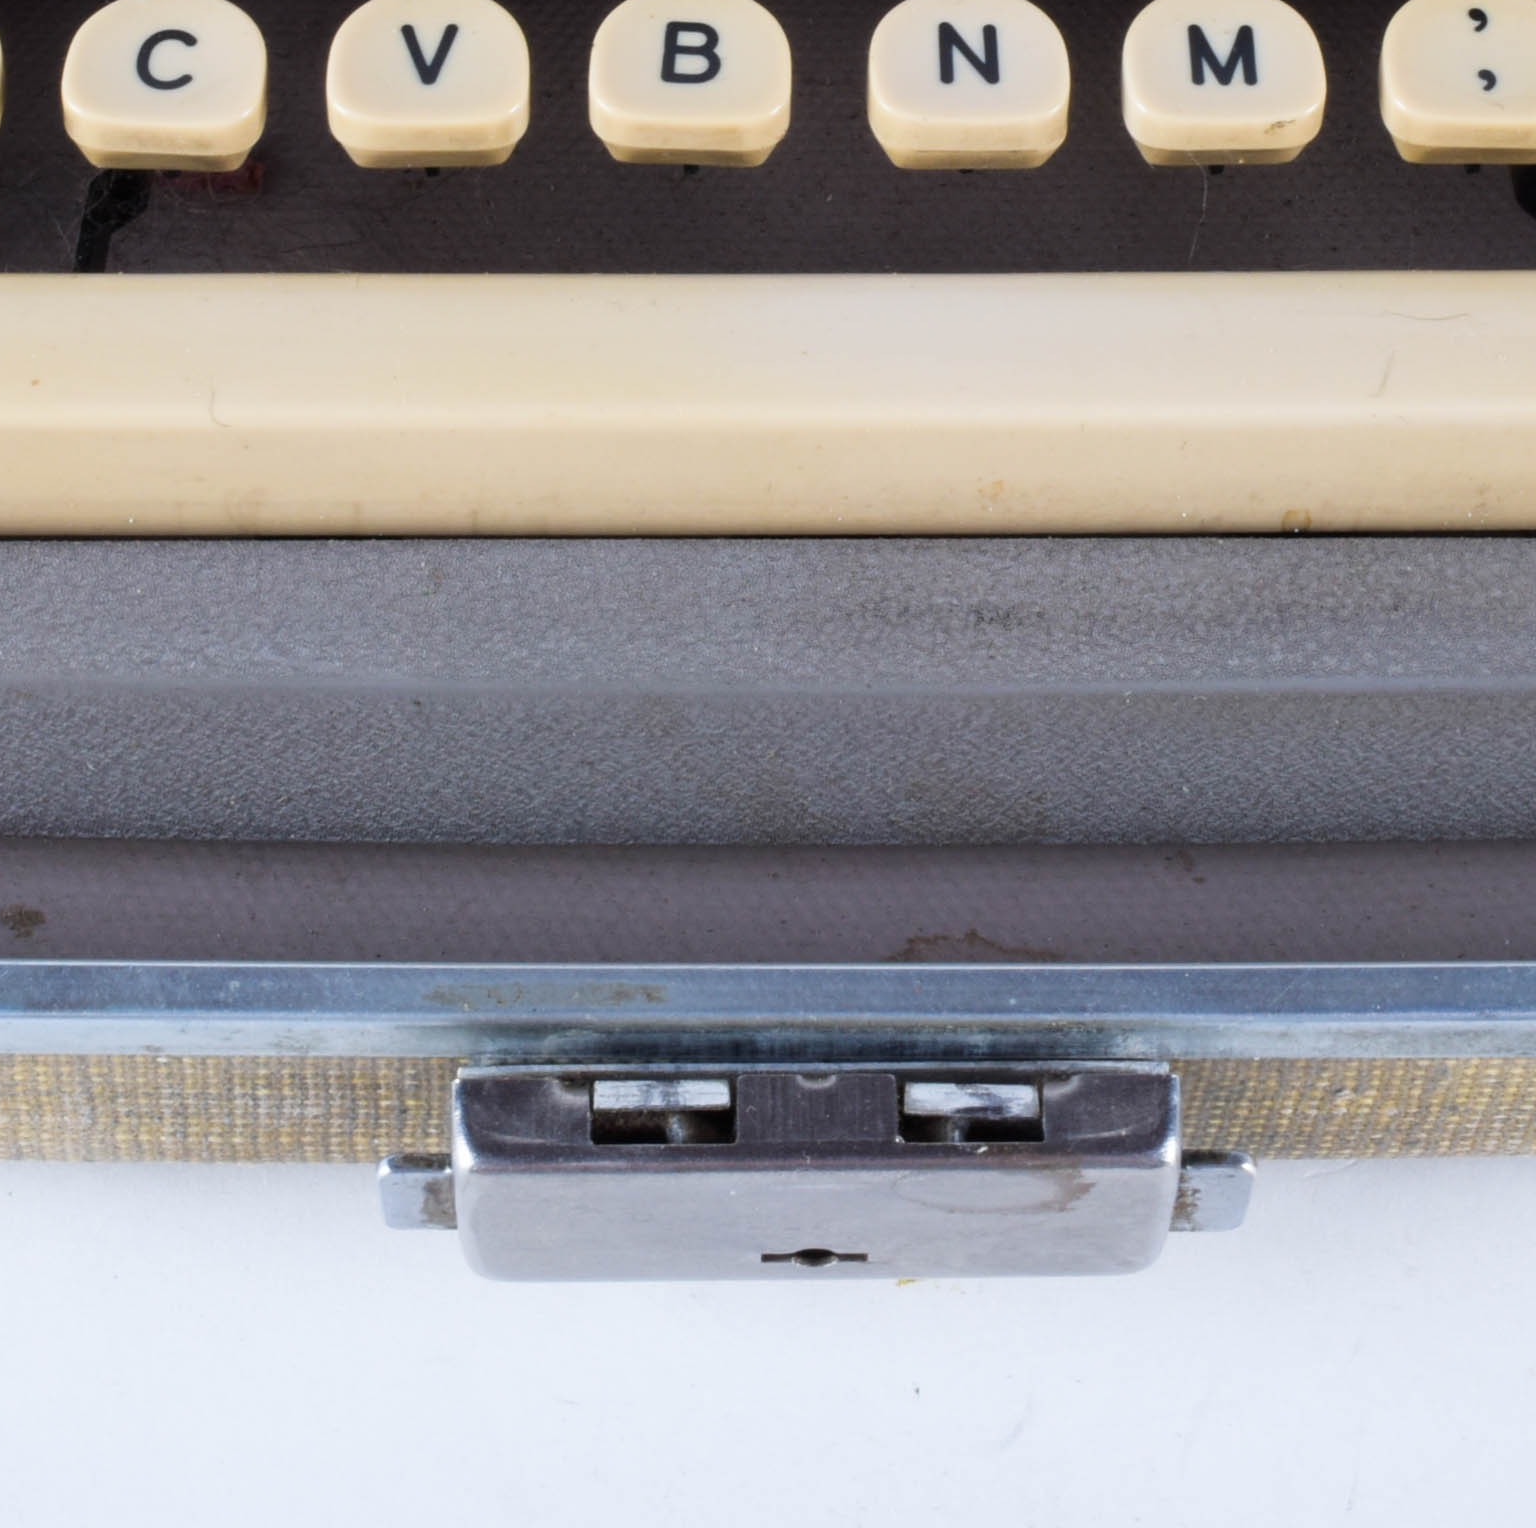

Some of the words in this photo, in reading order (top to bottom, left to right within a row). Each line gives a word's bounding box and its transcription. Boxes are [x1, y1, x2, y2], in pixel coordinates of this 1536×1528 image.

[133, 27, 200, 93] C
[398, 21, 461, 88] V
[658, 18, 724, 86] B
[935, 19, 1002, 87] N
[1185, 21, 1260, 88] M
